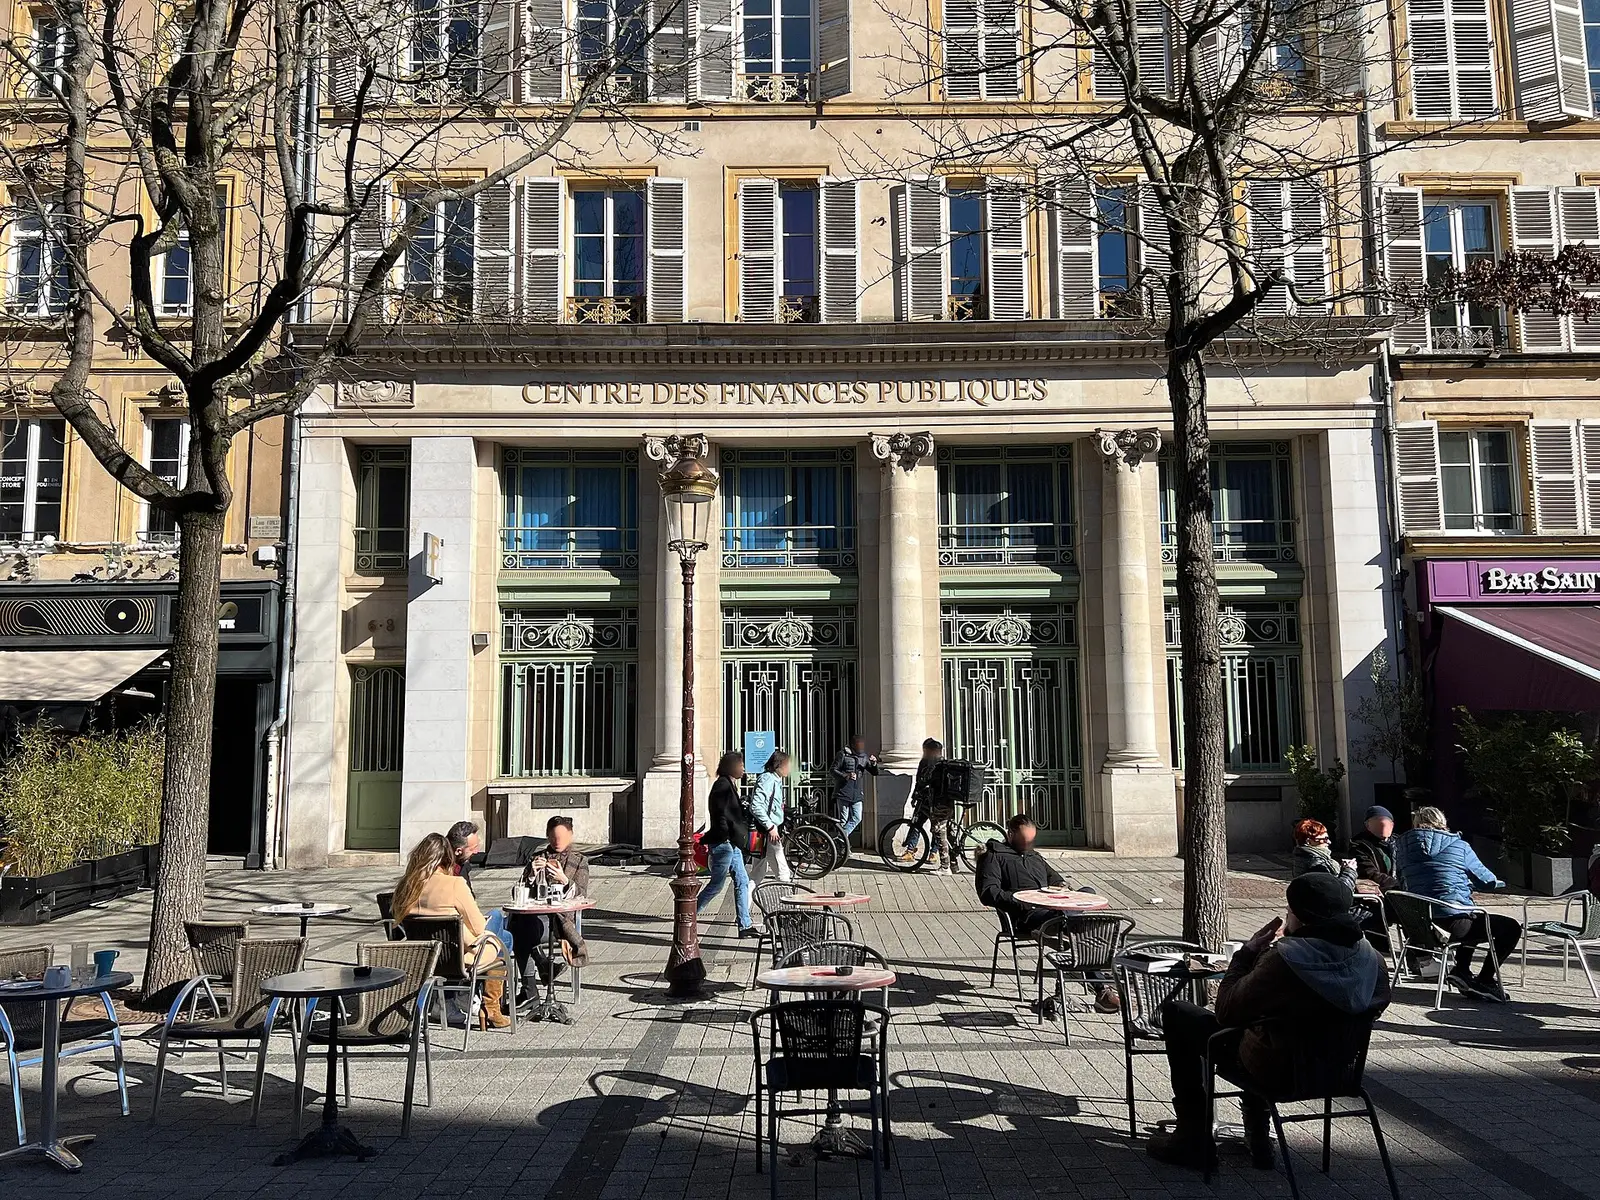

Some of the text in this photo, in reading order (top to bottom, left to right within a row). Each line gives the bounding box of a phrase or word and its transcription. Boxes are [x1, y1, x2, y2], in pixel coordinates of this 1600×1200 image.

[522, 378, 1048, 407] CENTRE DES FINANCES PUBLIQUES
[1541, 566, 1600, 590] SAIN
